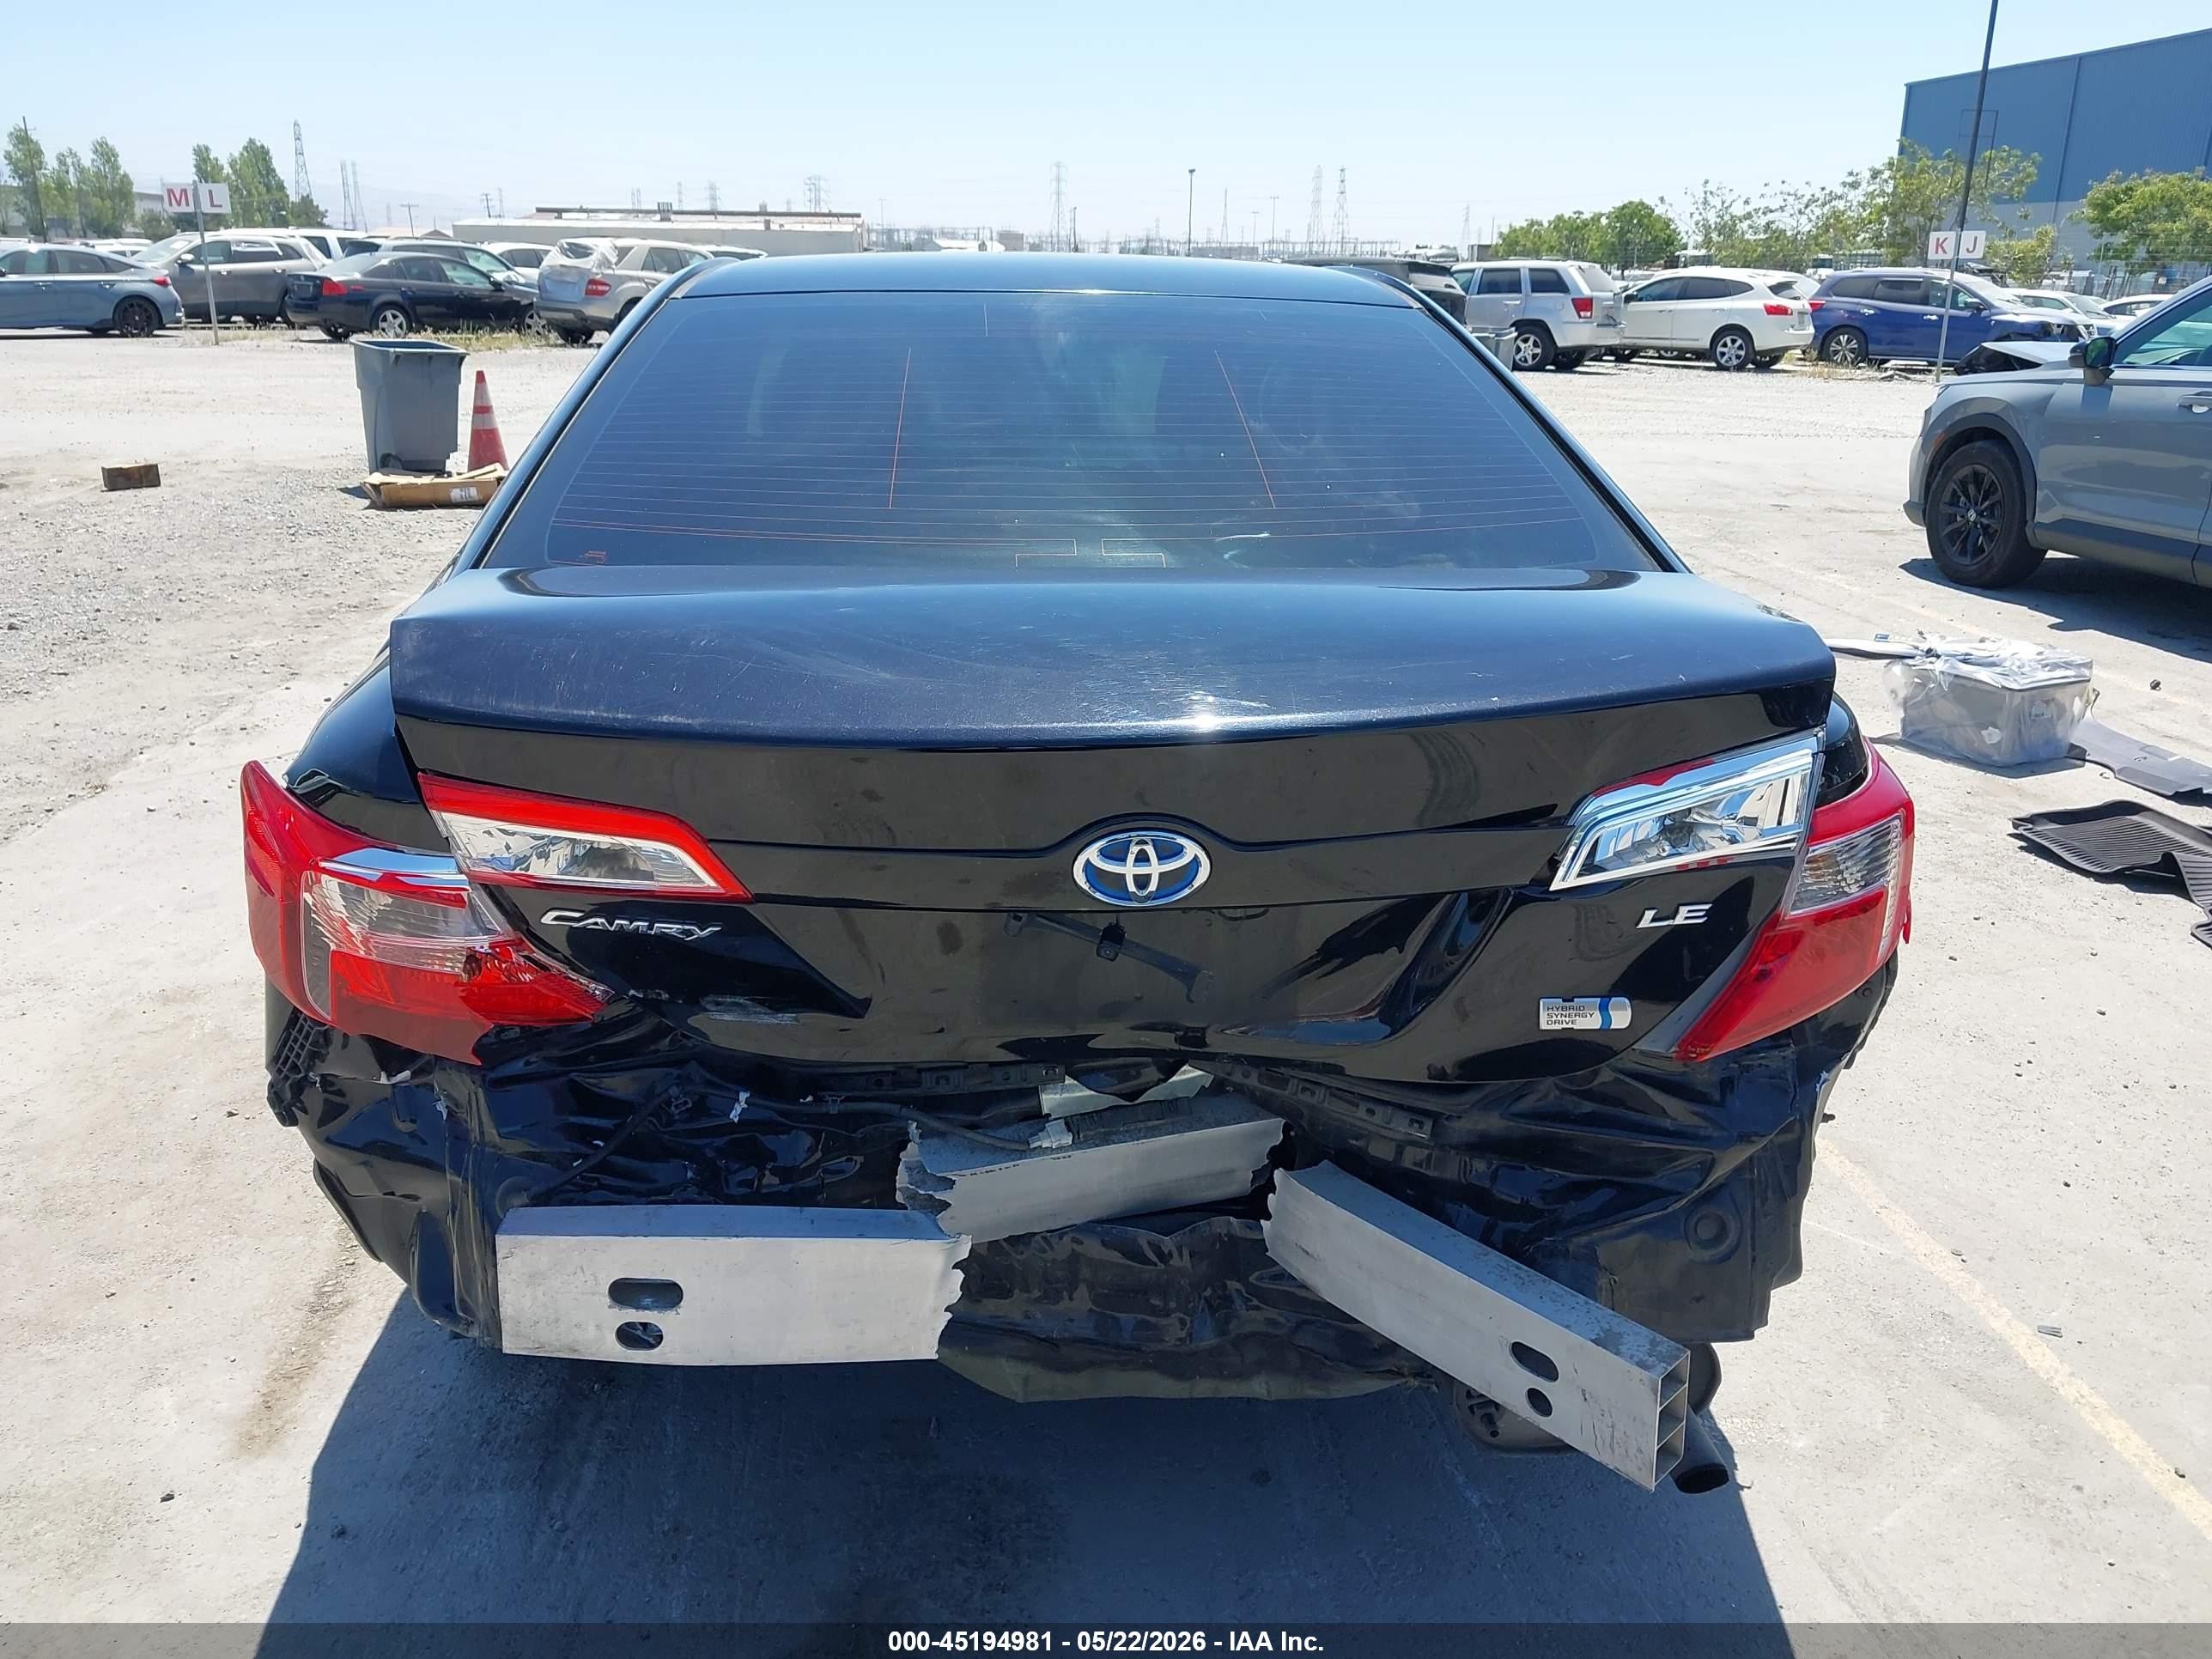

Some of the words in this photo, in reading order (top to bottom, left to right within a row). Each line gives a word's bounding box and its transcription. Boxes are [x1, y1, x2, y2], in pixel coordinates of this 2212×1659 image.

[167, 188, 190, 207] M
[208, 189, 223, 207] L
[1935, 236, 1948, 255] K
[1966, 235, 1978, 253] J
[540, 909, 722, 940] CAMRY
[1636, 902, 1713, 928] LE
